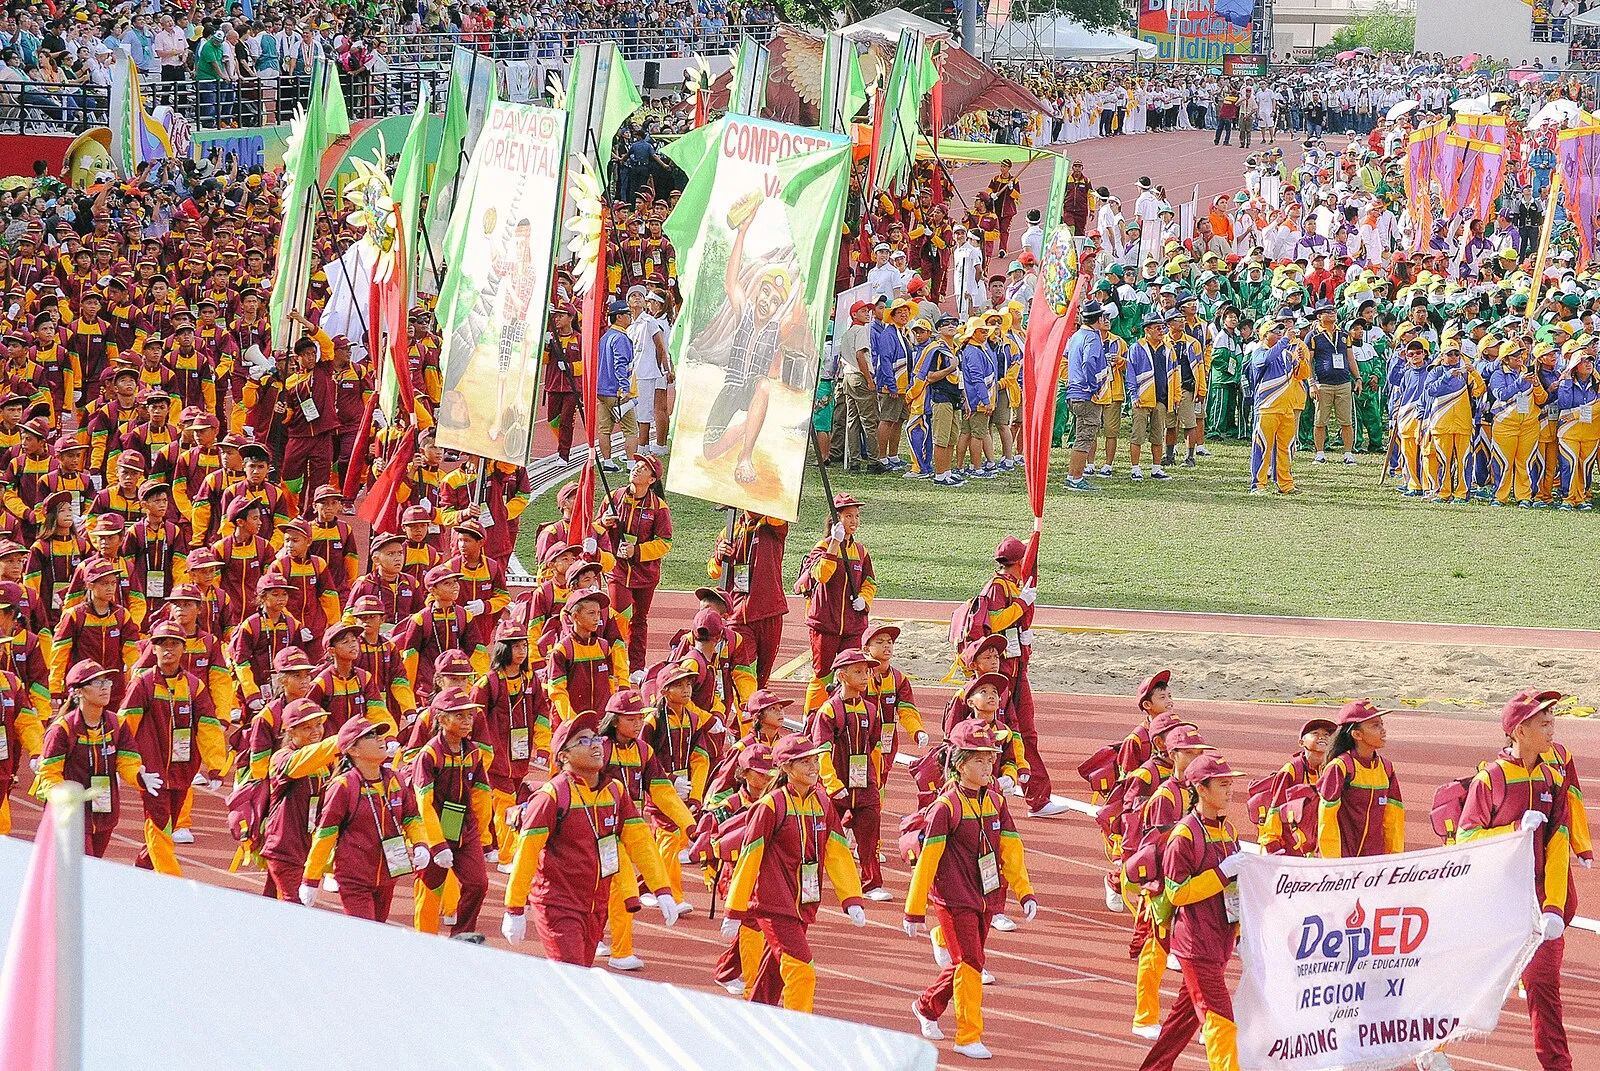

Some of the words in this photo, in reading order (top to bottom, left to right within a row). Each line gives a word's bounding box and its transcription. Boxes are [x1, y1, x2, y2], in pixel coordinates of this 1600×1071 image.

[1167, 14, 1248, 39] Borders,
[492, 108, 555, 139] DAVAO
[484, 138, 556, 179] ORIENTAL
[1276, 871, 1363, 899] Department
[1364, 868, 1387, 888] of
[1388, 860, 1471, 885] Education
[1296, 906, 1429, 974] DepED
[1297, 961, 1346, 977] DEPARTMENT
[1357, 960, 1369, 970] OF
[1372, 958, 1421, 970] EDUCATION
[1301, 981, 1366, 1009] REGION
[1385, 978, 1406, 998] XI
[1330, 1006, 1359, 1022] joins
